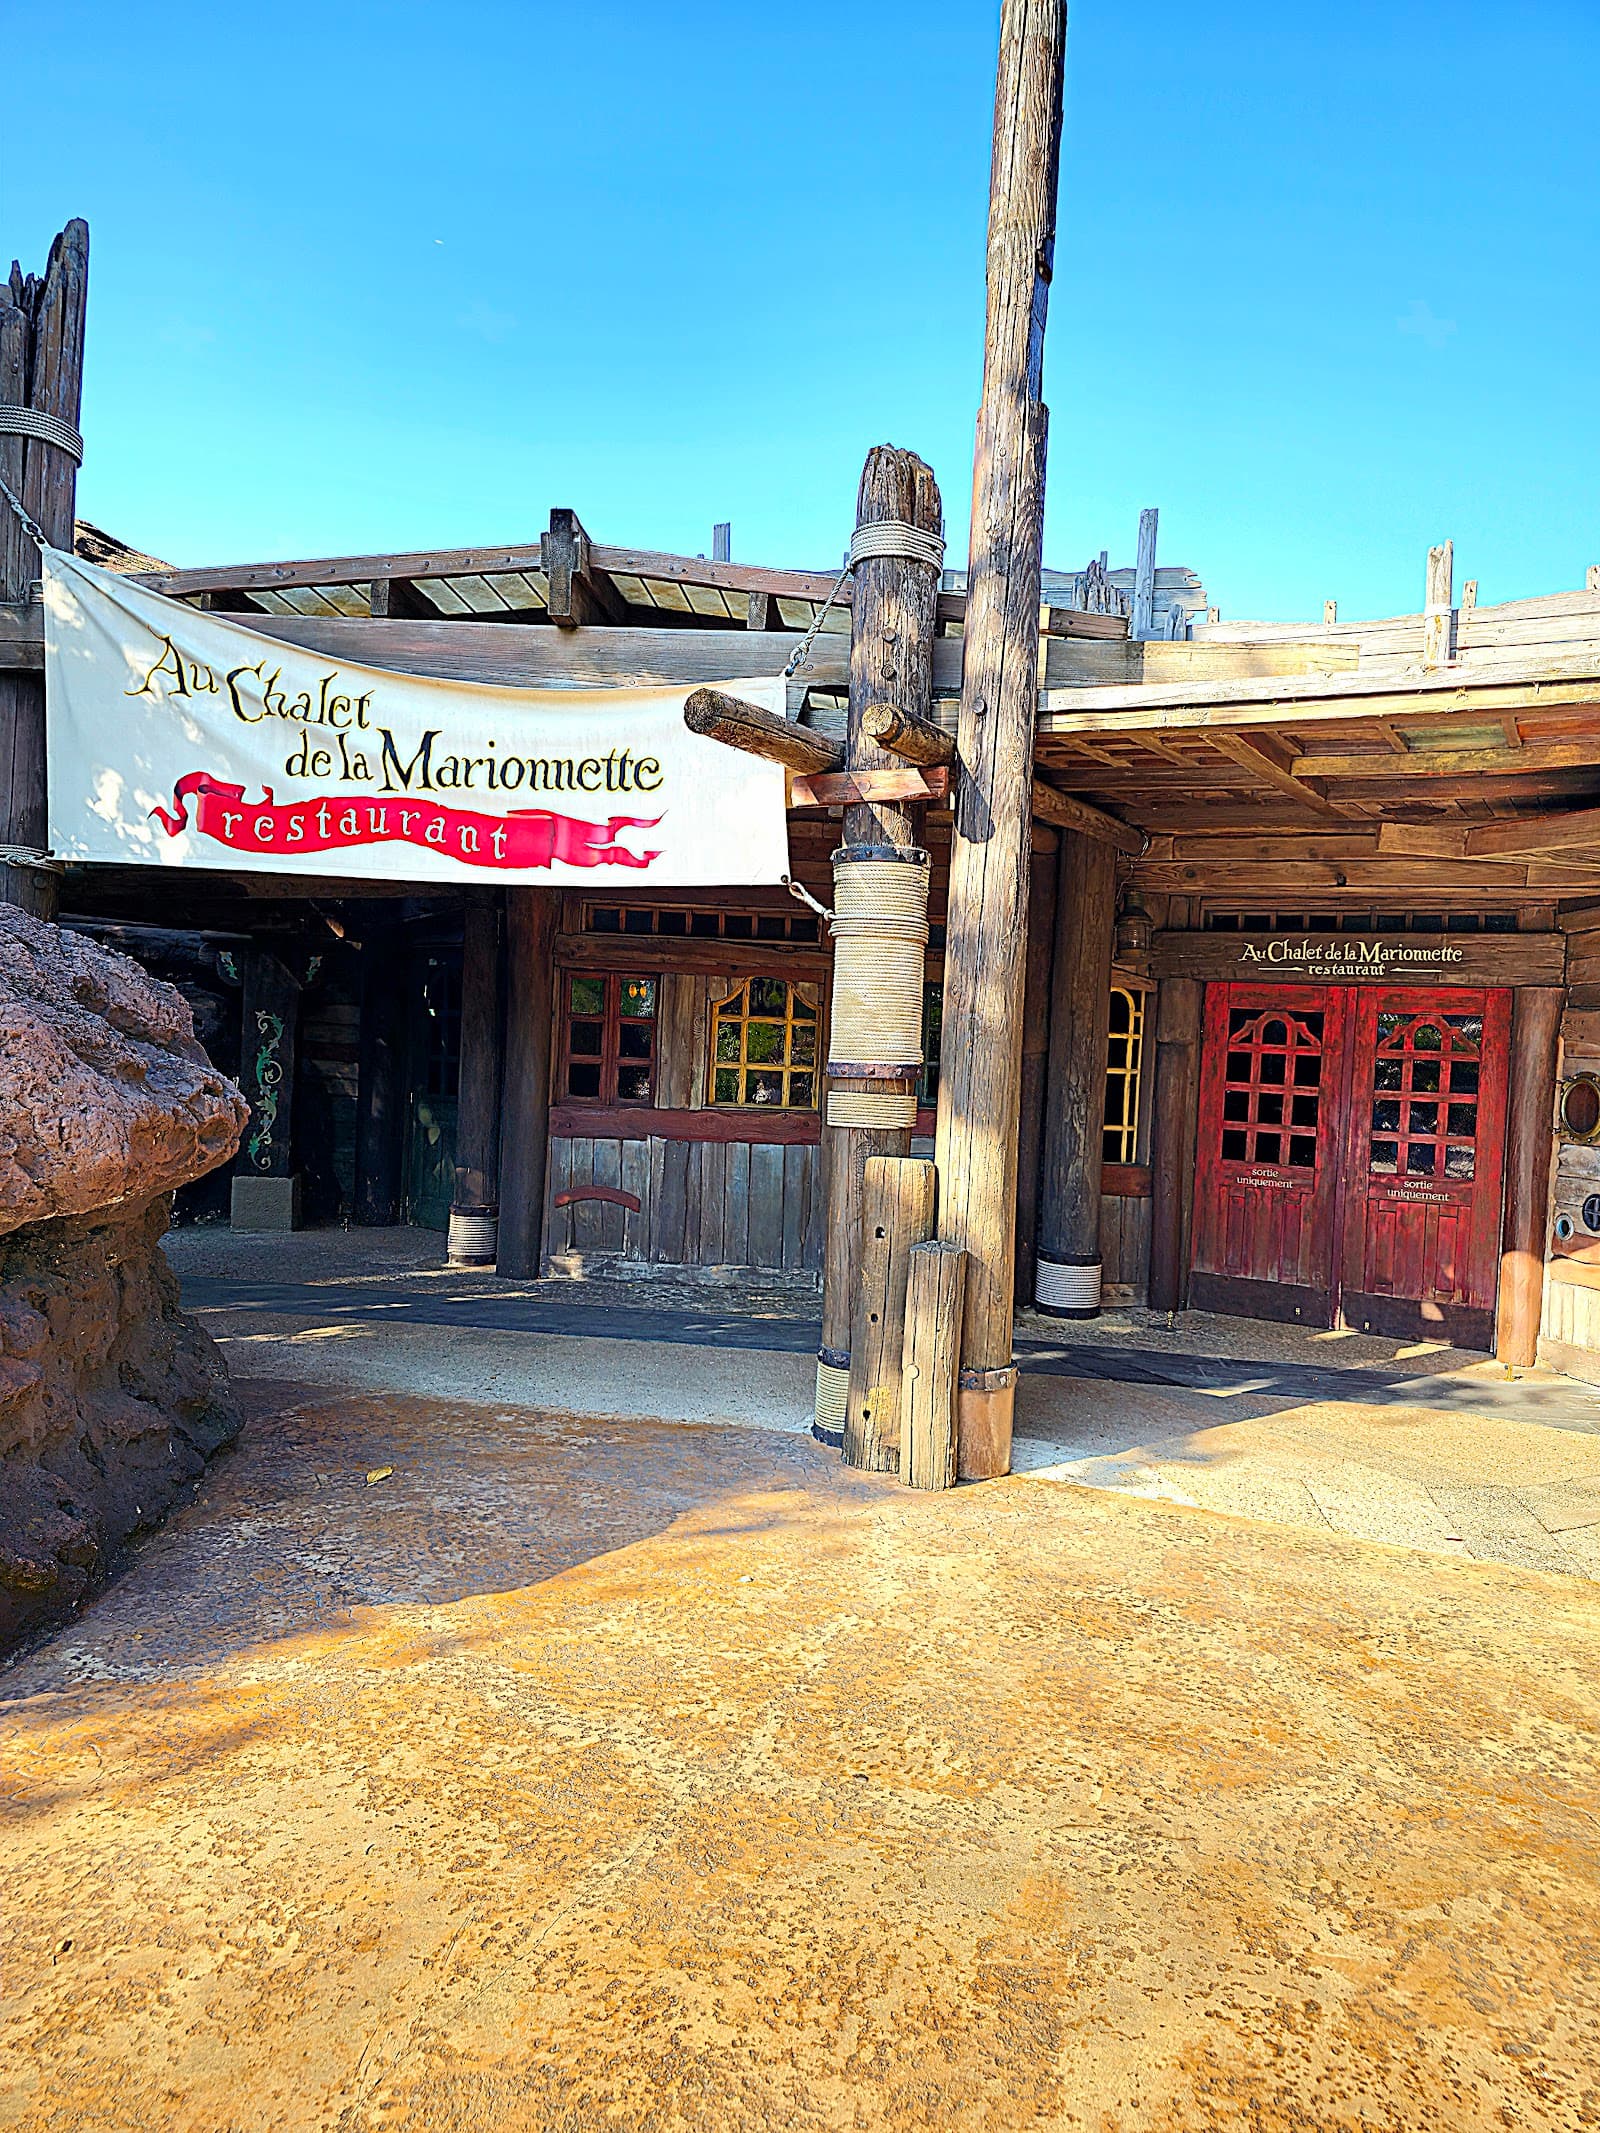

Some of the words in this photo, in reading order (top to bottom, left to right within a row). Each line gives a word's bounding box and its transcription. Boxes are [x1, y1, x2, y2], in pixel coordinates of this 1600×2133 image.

[124, 624, 220, 698] Au
[226, 660, 376, 729] Chalet
[285, 728, 332, 780] de
[335, 730, 375, 782] la
[375, 728, 664, 792] Marionnette
[221, 802, 508, 860] restaurant
[1238, 943, 1267, 962] Au
[1267, 938, 1322, 962] Chalet
[1324, 942, 1342, 960] de
[1343, 943, 1358, 960] la
[1356, 941, 1463, 963] Marionnette
[1308, 963, 1386, 976] restaurant
[1251, 1168, 1280, 1178] sortie
[1236, 1177, 1294, 1189] uniquement
[1403, 1180, 1434, 1190] sortie
[1387, 1189, 1450, 1202] uniquement
